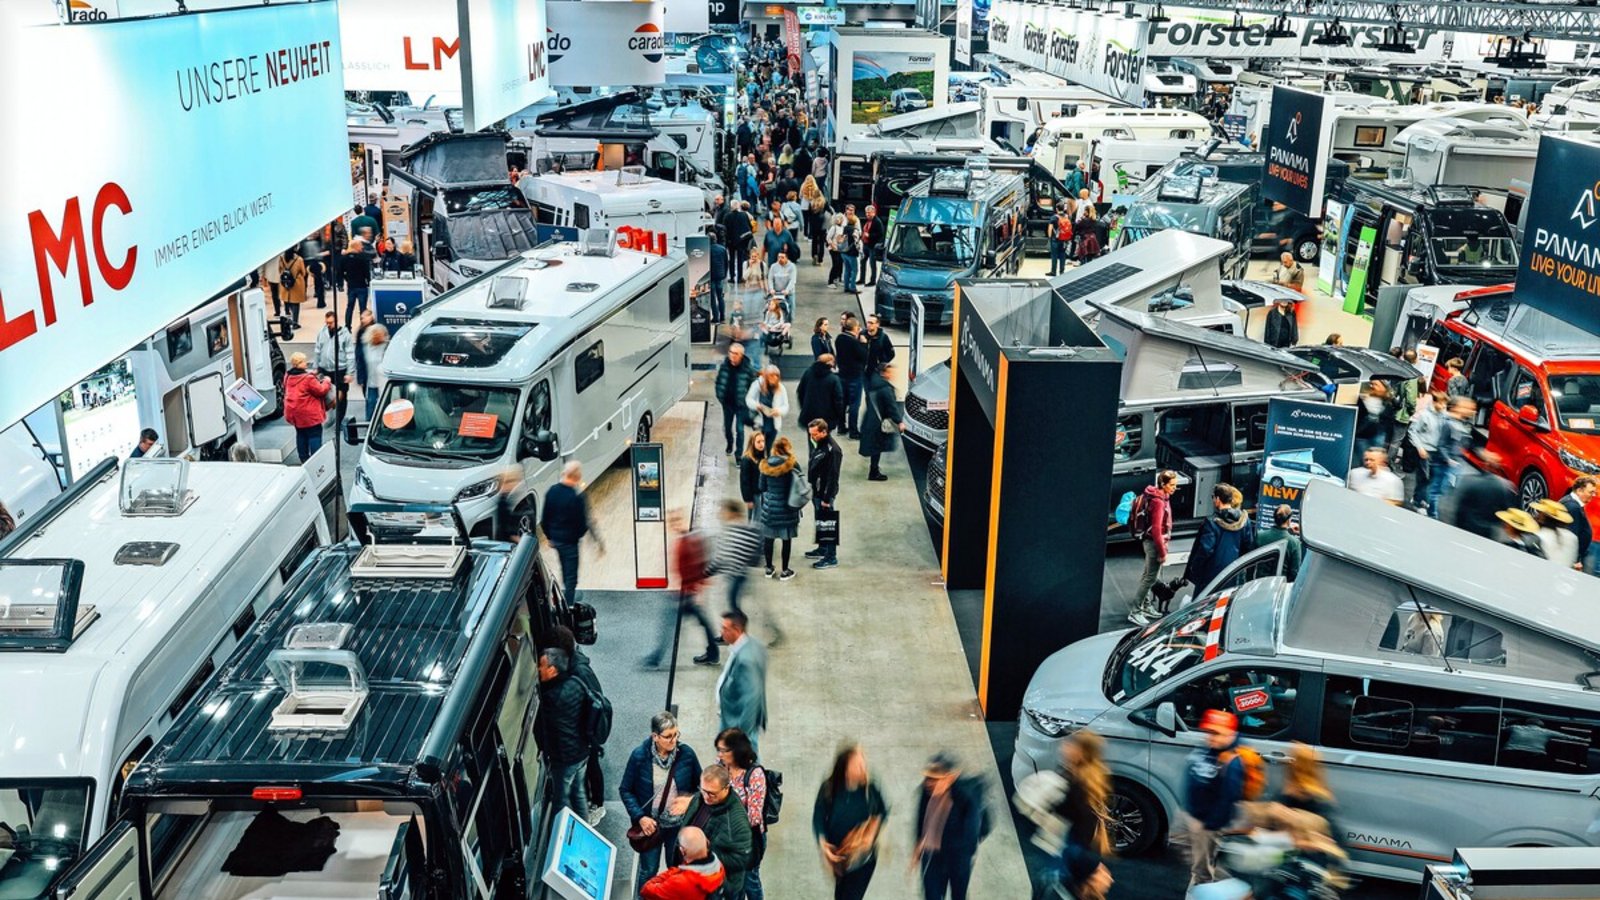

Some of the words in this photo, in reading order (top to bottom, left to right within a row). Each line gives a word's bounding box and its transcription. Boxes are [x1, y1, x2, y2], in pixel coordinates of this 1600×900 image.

[72, 8, 108, 21] rado
[403, 36, 461, 70] LM
[628, 36, 663, 50] carad
[1023, 25, 1047, 54] Forster
[1050, 30, 1080, 64] Forster
[177, 55, 261, 111] UNSERE
[266, 41, 330, 88] NEUHEIT
[528, 41, 546, 81] LMC
[1103, 43, 1145, 84] Forster
[1271, 146, 1309, 173] PANAMA
[154, 235, 190, 267] IMMER
[192, 219, 221, 249] EINEN
[223, 204, 249, 232] BLICK
[1534, 228, 1600, 269] PANA
[0, 182, 138, 351] LMC
[1557, 261, 1587, 290] YOUR
[969, 333, 994, 393] PANAMA
[1300, 411, 1332, 420] PANAMA
[1263, 484, 1298, 500] NEW
[1347, 831, 1412, 849] PANAMA
